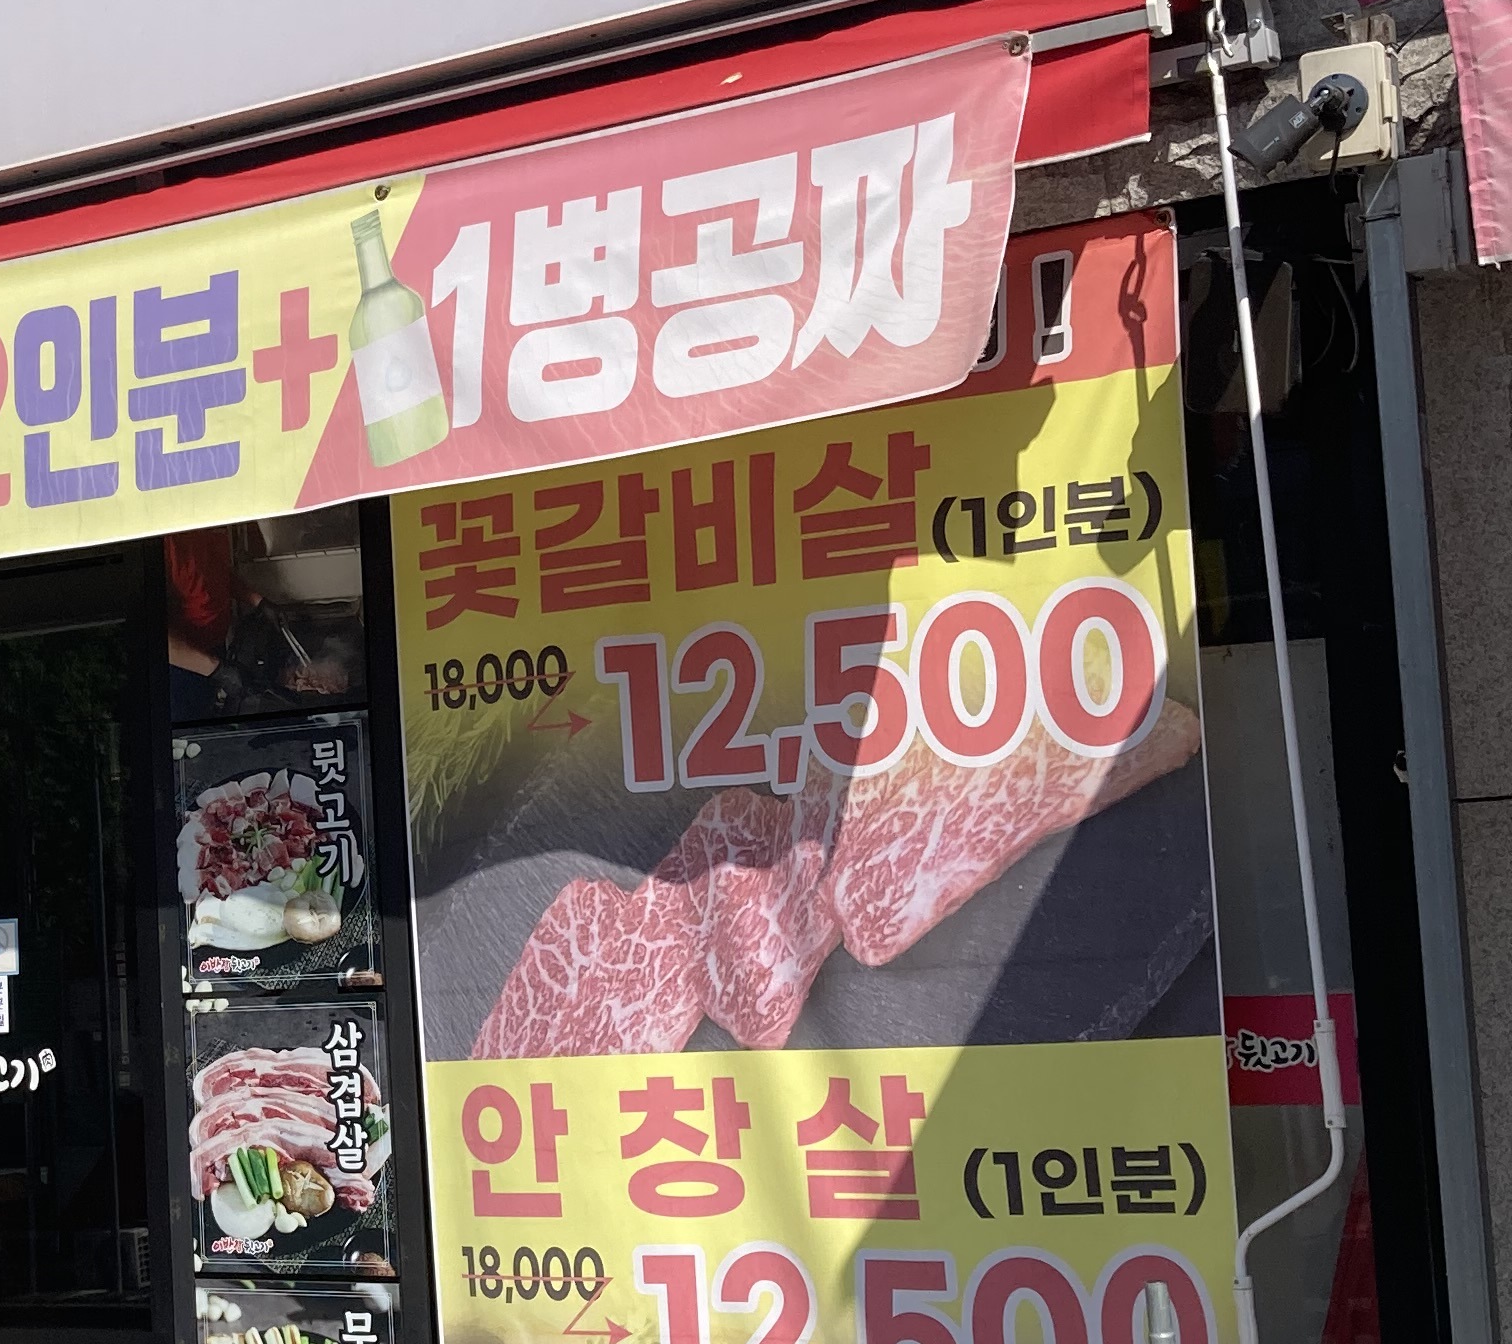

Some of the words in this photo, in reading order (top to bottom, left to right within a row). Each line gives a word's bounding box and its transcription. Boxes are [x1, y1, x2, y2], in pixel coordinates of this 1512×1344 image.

[430, 111, 973, 430] 1병공짜
[418, 431, 932, 632] 꽃갈비살
[932, 471, 1163, 564] (1인분)
[424, 646, 571, 713] 18,000
[597, 577, 1168, 795] 12,500
[312, 739, 350, 883] 뒷고기
[325, 1022, 368, 1170] 삼겹살
[1235, 1029, 1318, 1072] 뒷고기
[962, 1142, 1207, 1221] (1인분)
[462, 1246, 606, 1303] 18,000
